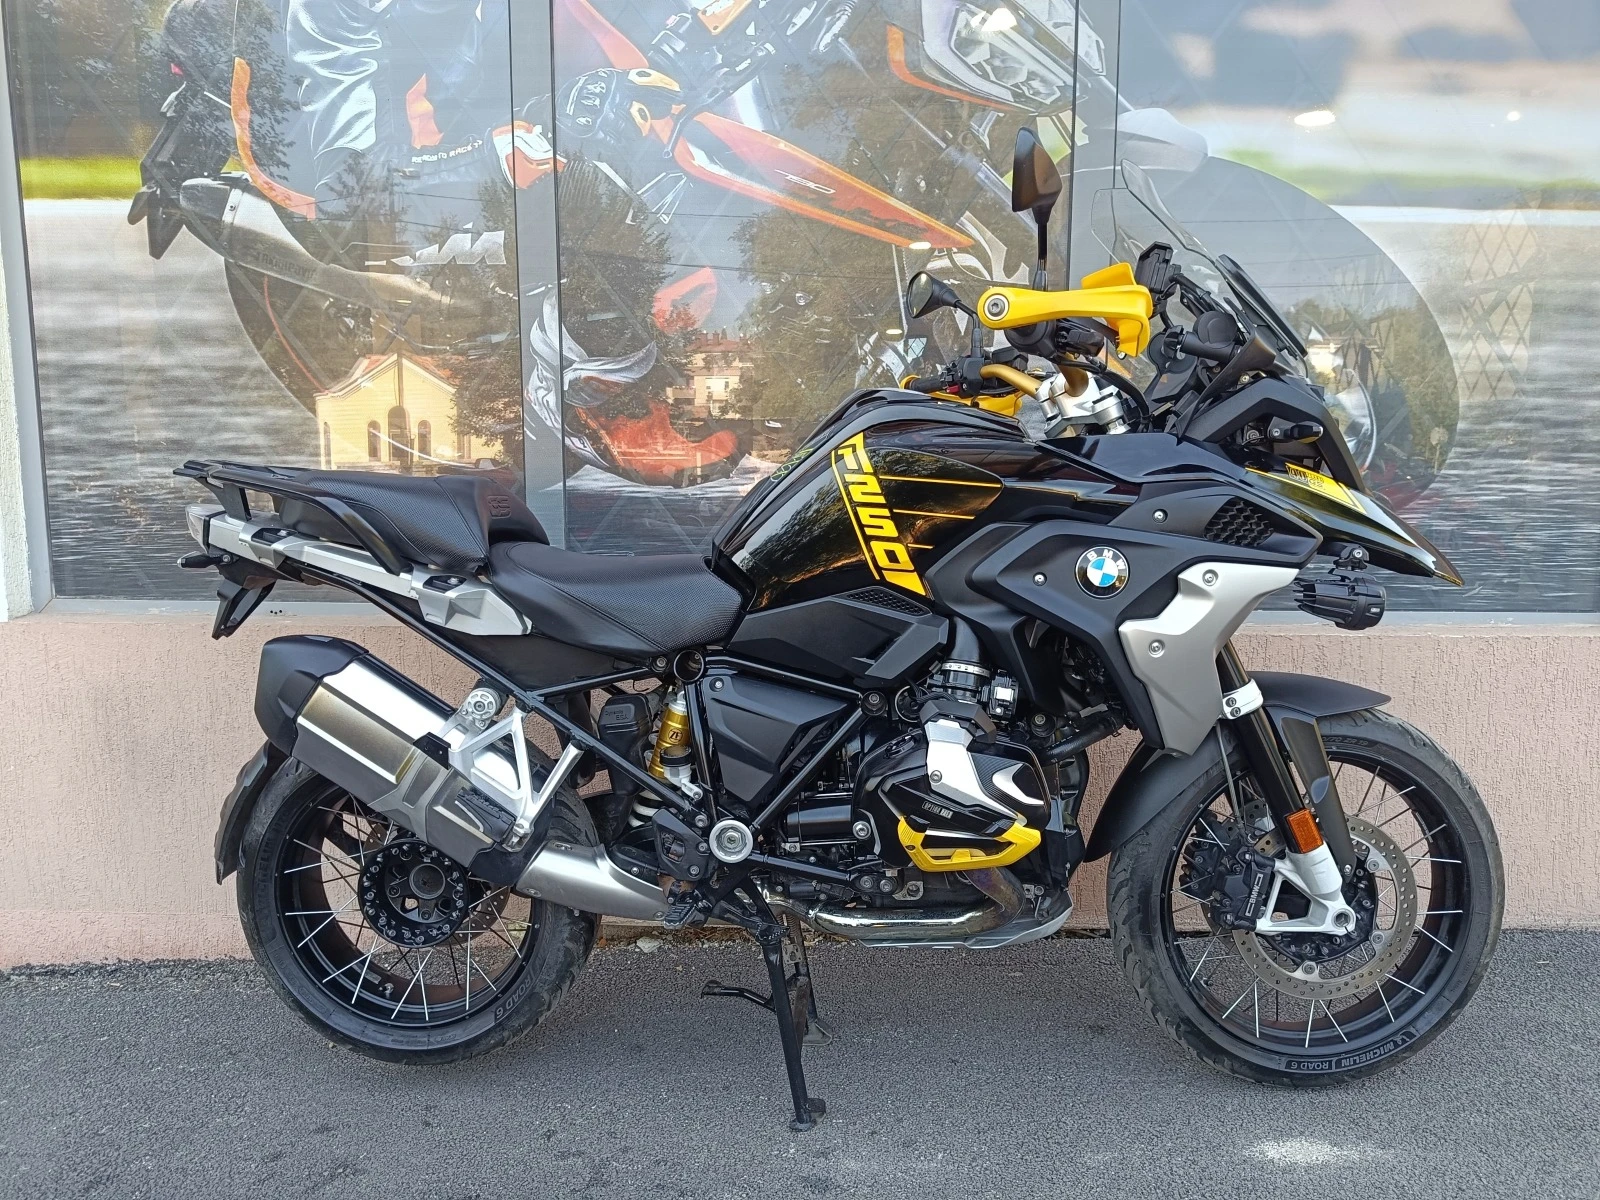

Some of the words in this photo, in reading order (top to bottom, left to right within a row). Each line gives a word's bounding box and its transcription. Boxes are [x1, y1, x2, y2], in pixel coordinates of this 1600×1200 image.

[1086, 548, 1126, 570] BMW
[669, 730, 682, 740] ZF
[1249, 884, 1261, 904] BMW
[505, 975, 532, 1010] ROAD
[1300, 1061, 1329, 1070] ROAD
[1341, 1043, 1396, 1067] MICHELIN
